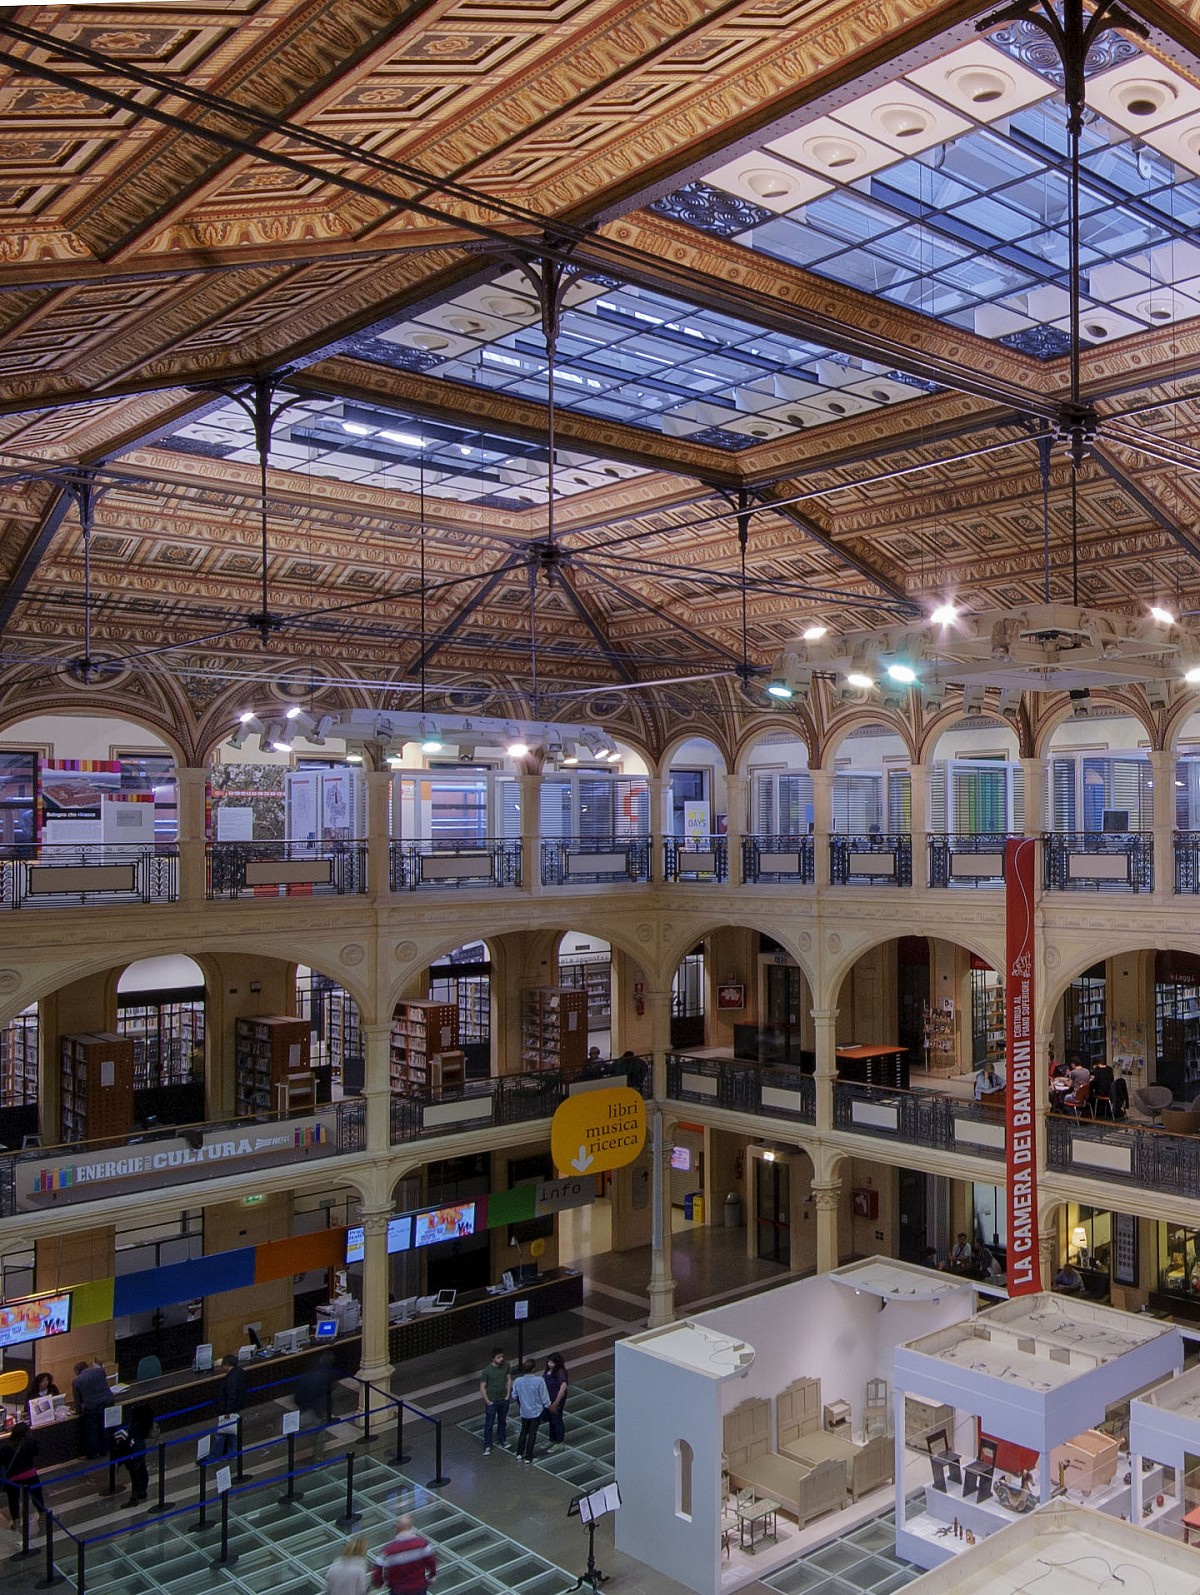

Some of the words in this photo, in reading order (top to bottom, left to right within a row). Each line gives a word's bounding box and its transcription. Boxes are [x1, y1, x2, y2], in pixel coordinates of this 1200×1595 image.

[1014, 995, 1021, 1004] AL
[1022, 979, 1030, 1015] SUPERIORE
[1022, 1017, 1030, 1037] PIANO
[1013, 1040, 1032, 1127] BAMBINI
[608, 1100, 638, 1119] libri
[586, 1118, 639, 1138] musica
[589, 1134, 639, 1154] ricerca
[1013, 1129, 1032, 1165] DEI
[75, 1156, 144, 1183] ENERGIE
[153, 1139, 253, 1169] CULTURA
[542, 1182, 581, 1201] info
[1013, 1167, 1032, 1251] CAMERA
[1013, 1256, 1032, 1284] LA
